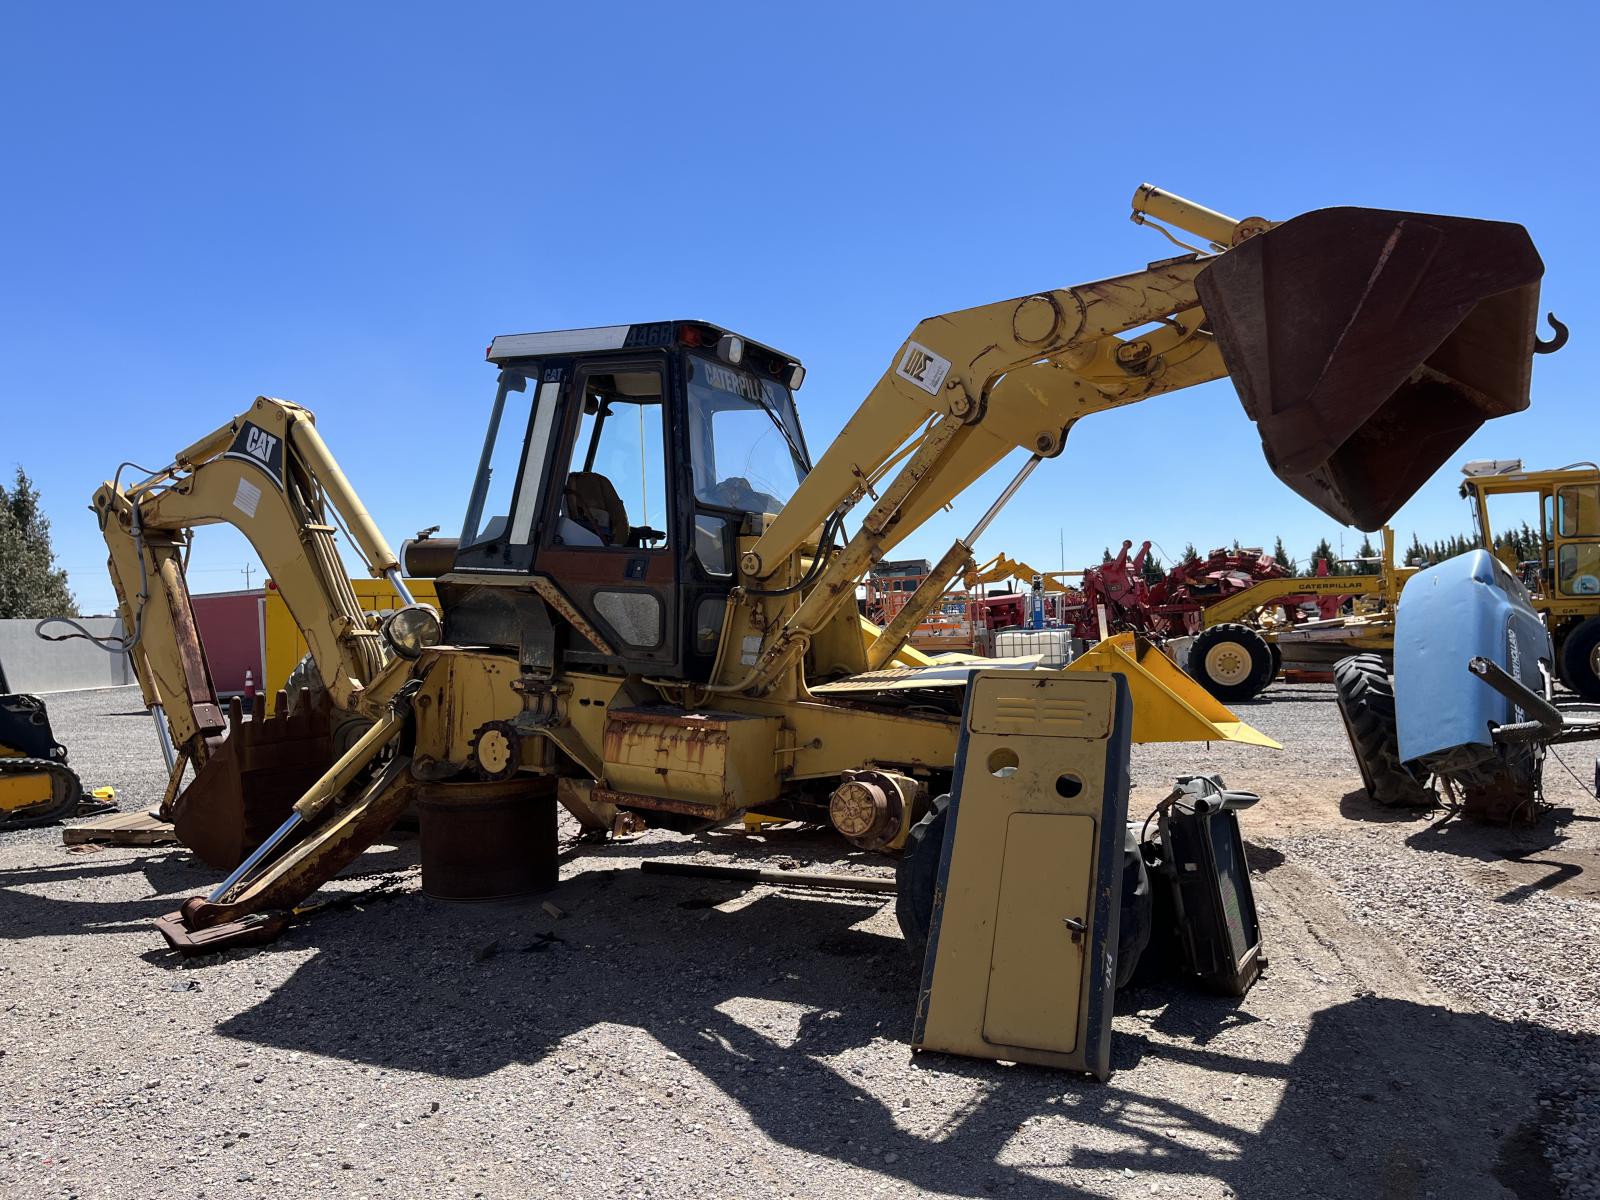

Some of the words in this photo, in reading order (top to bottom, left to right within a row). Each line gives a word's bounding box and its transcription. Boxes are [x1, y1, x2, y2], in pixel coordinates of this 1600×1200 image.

[544, 368, 563, 381] CAT
[705, 363, 776, 404] CATERPILLAR
[246, 426, 277, 463] CAT
[1299, 582, 1362, 590] CATERPILLAR
